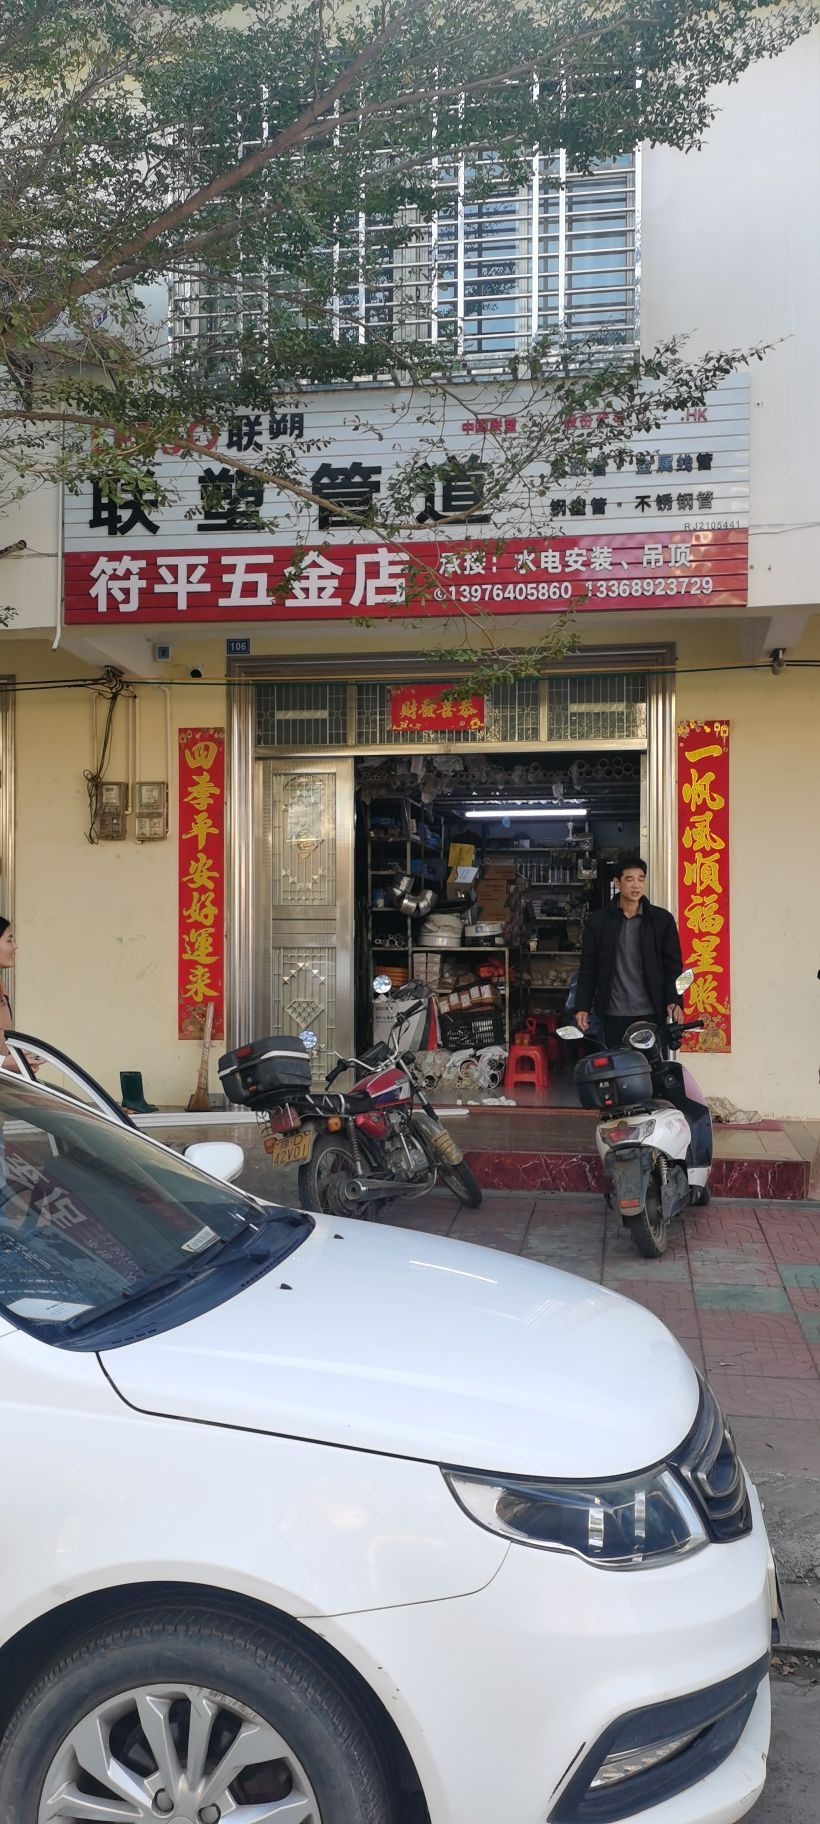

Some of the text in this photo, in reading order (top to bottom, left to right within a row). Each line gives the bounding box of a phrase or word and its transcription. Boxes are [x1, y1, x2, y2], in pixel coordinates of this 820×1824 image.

[89, 453, 491, 535] 联塑管道
[684, 520, 740, 531] RJ2105441
[89, 547, 410, 612] 符平五金店
[448, 577, 713, 602] 13976405860 13368923729
[231, 641, 248, 652] 106
